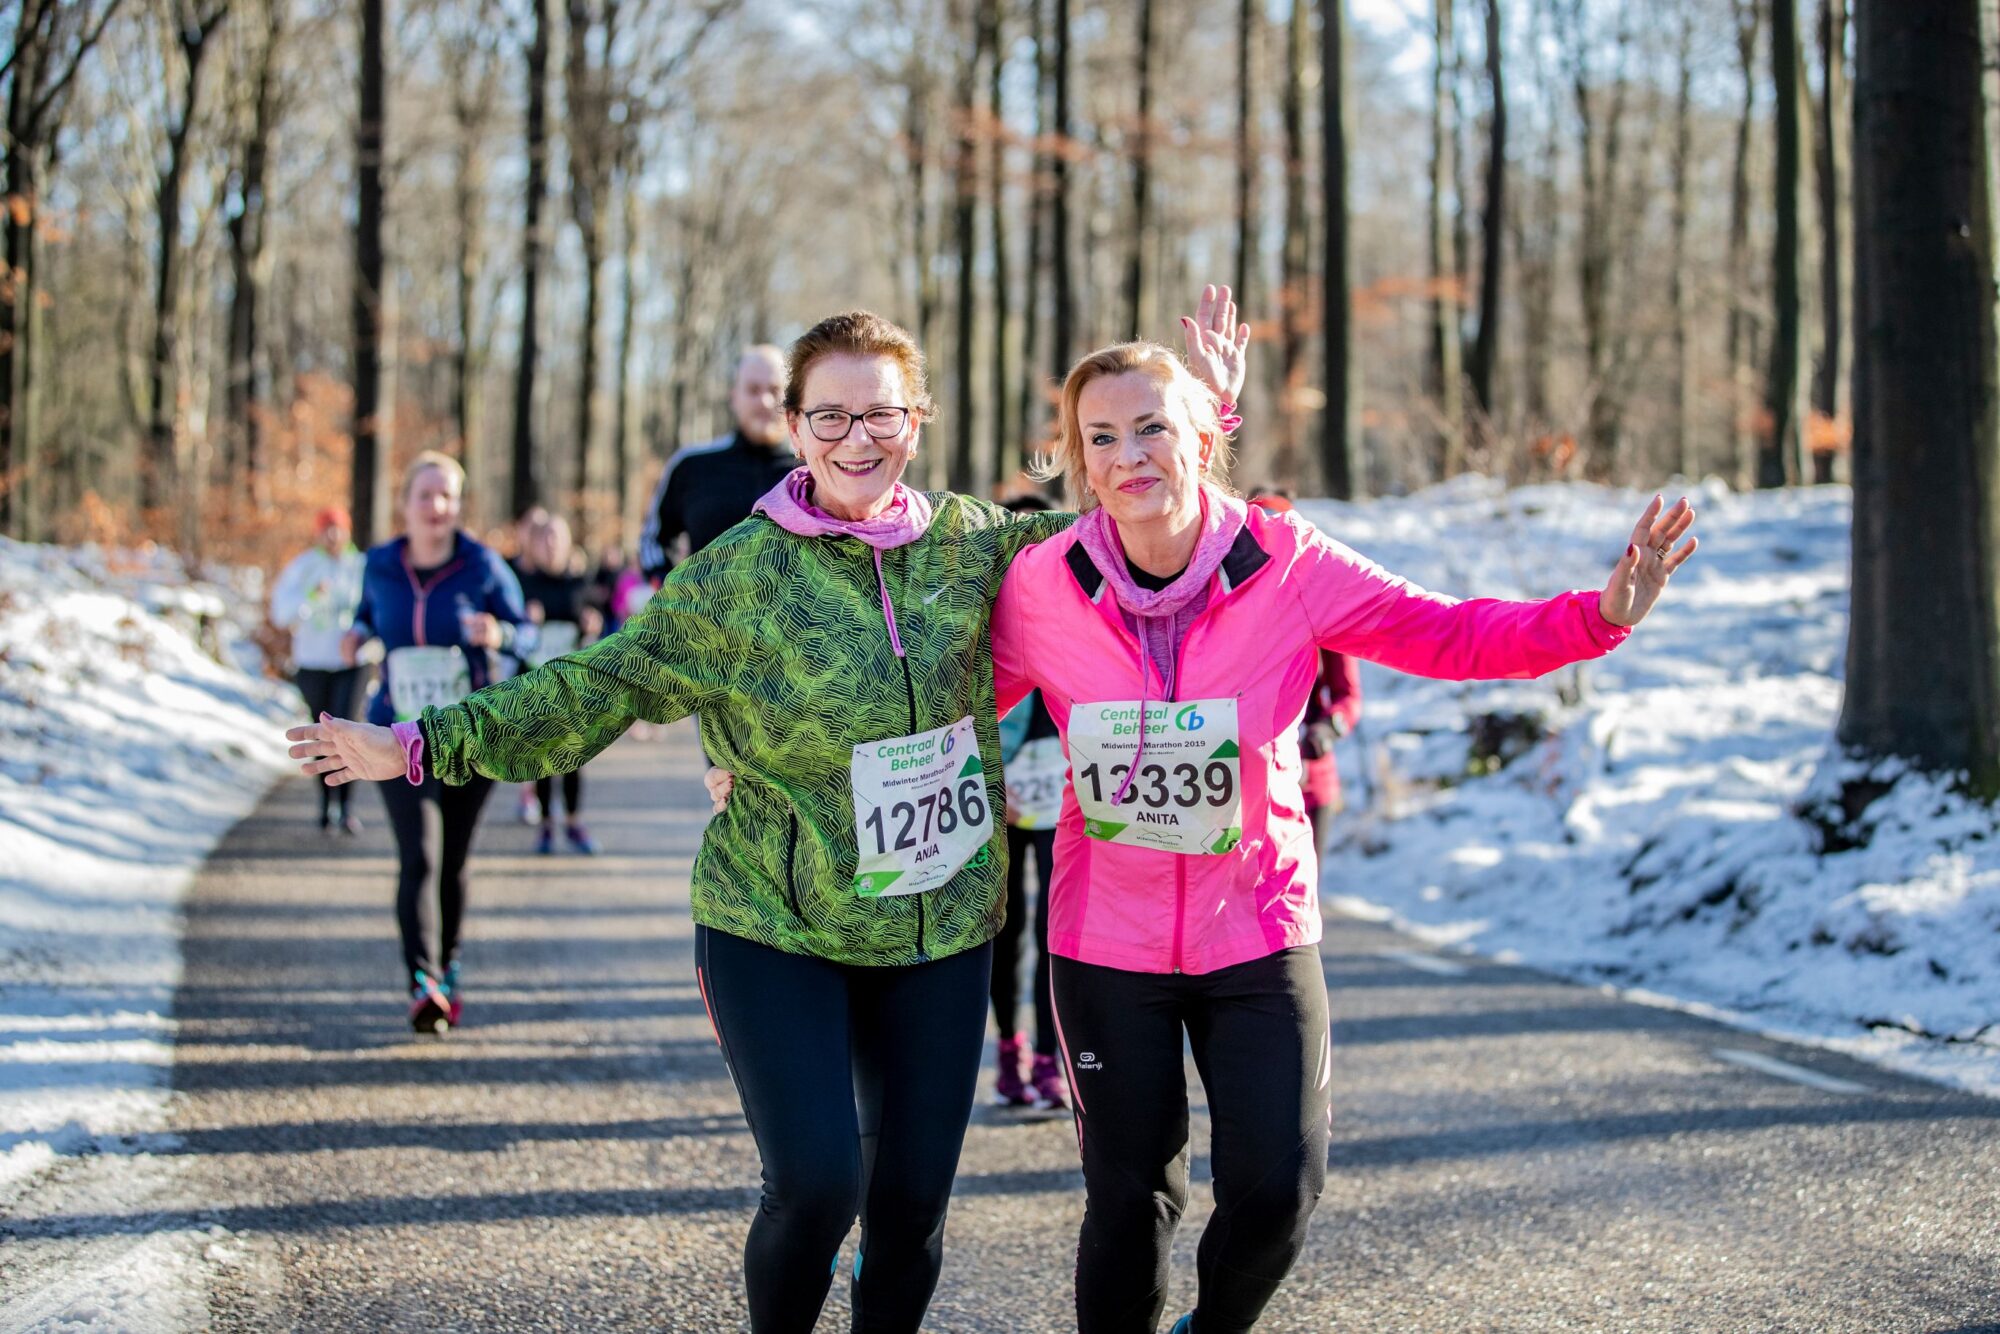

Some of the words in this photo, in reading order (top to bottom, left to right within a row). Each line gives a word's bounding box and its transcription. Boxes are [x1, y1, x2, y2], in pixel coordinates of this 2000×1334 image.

[1100, 707, 1168, 721] Centraal
[1112, 722, 1168, 736] Beheer
[877, 735, 936, 758] Centraal
[1143, 741, 1182, 749] Marathon
[1184, 740, 1206, 748] 2019
[891, 752, 935, 771] Beheer
[882, 776, 919, 788] Midwinter
[919, 768, 944, 780] Marathon
[1081, 761, 1233, 808] 13339
[865, 780, 986, 854] 12786
[1136, 811, 1180, 825] ANITA
[914, 843, 940, 863] ANJA
